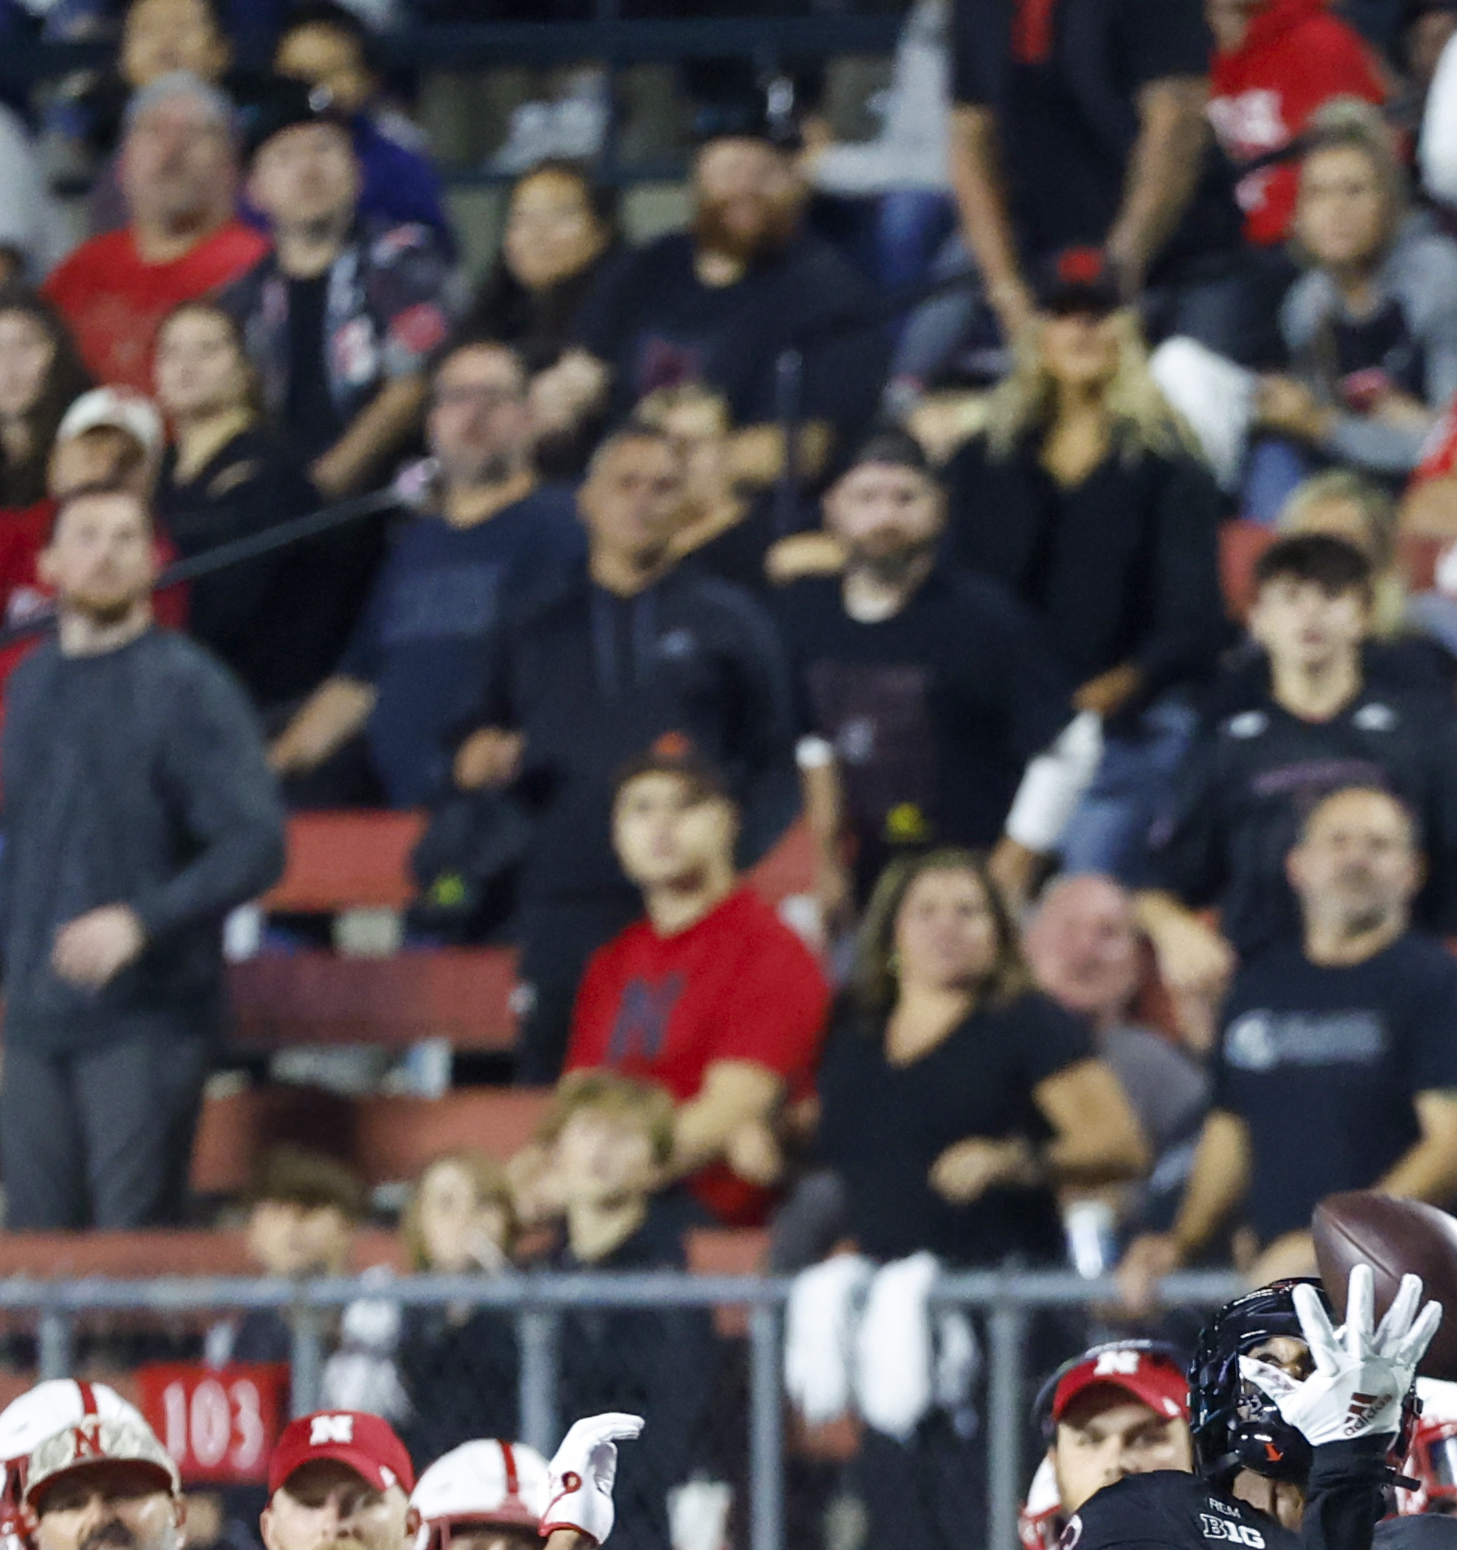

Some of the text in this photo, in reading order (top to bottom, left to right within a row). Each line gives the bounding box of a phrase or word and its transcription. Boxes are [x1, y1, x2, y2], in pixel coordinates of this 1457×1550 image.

[1094, 1351, 1140, 1376] N
[72, 1422, 106, 1459] N
[163, 1379, 264, 1470] 103
[310, 1414, 354, 1446] N
